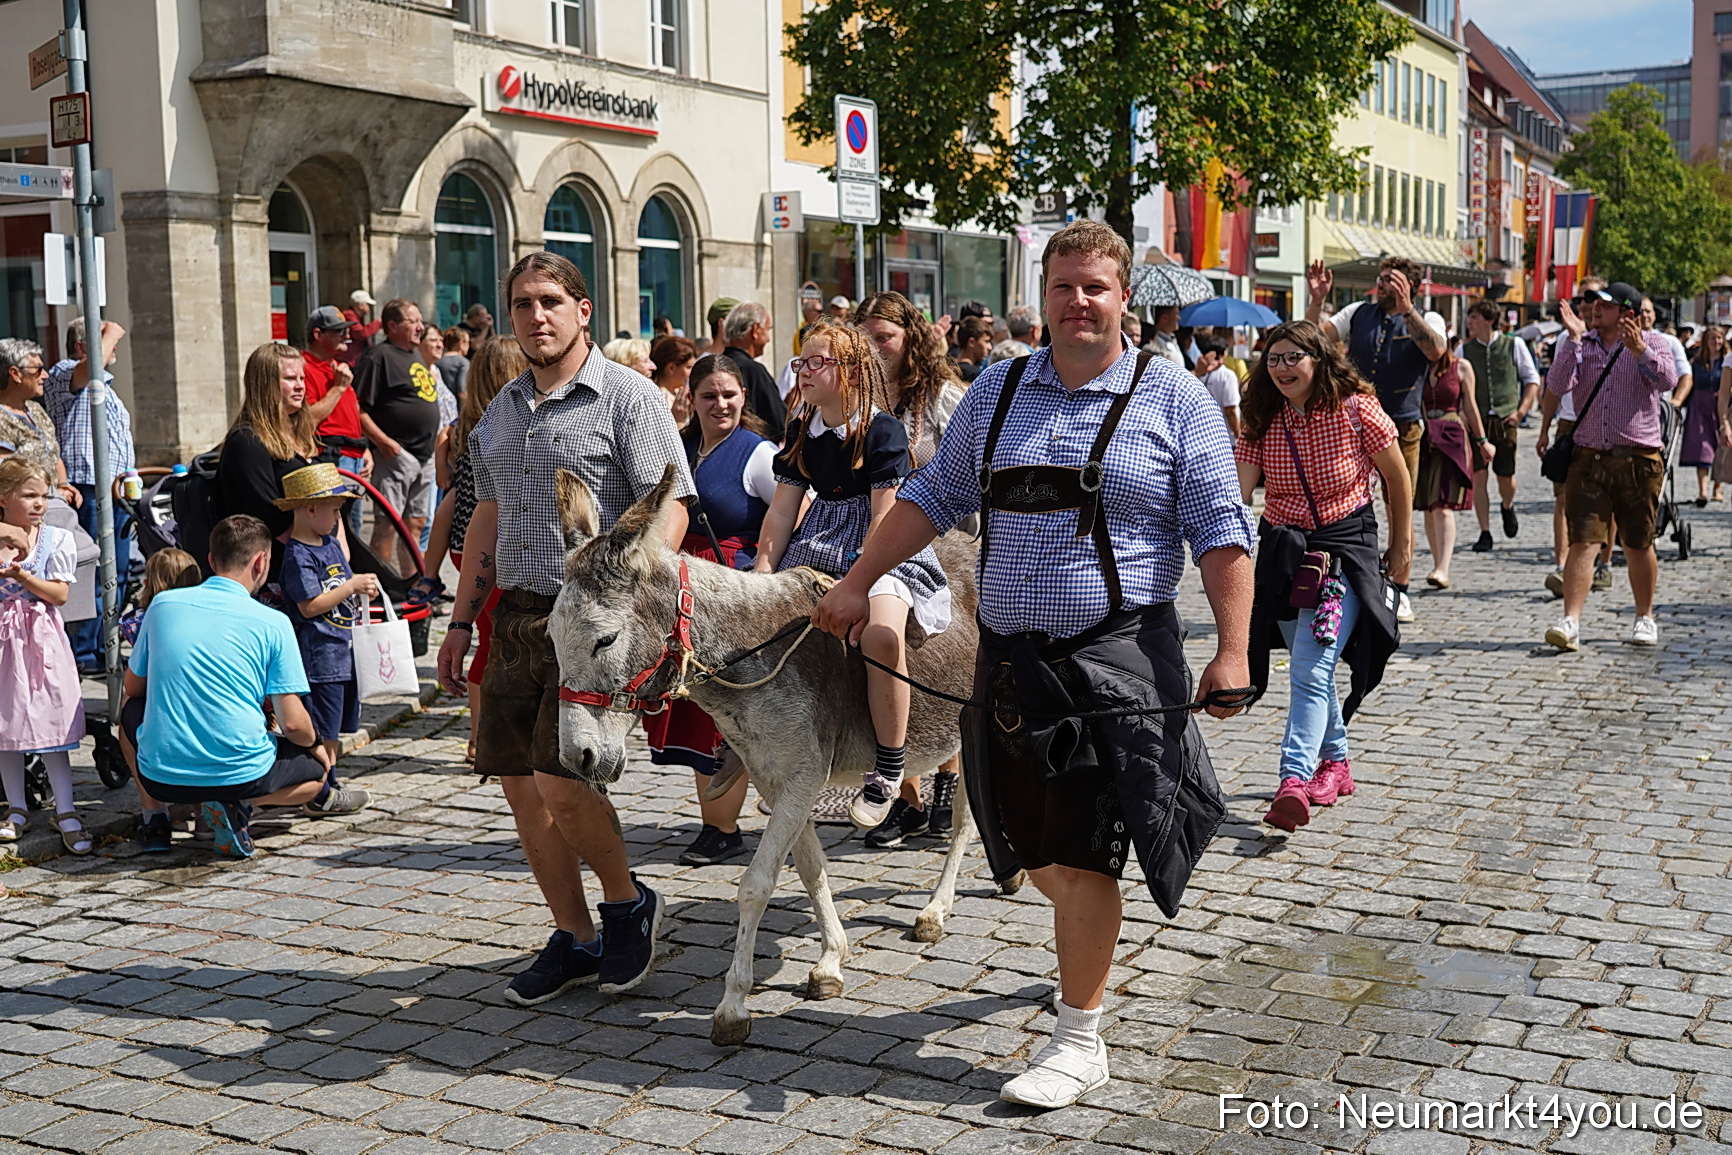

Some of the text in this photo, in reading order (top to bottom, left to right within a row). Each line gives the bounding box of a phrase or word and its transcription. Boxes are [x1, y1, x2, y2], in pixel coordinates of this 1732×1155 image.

[523, 71, 659, 120] HypoVereinsbank
[58, 99, 78, 112] H175
[849, 156, 867, 169] ZONE
[773, 196, 788, 212] EC
[1031, 194, 1057, 212] CB
